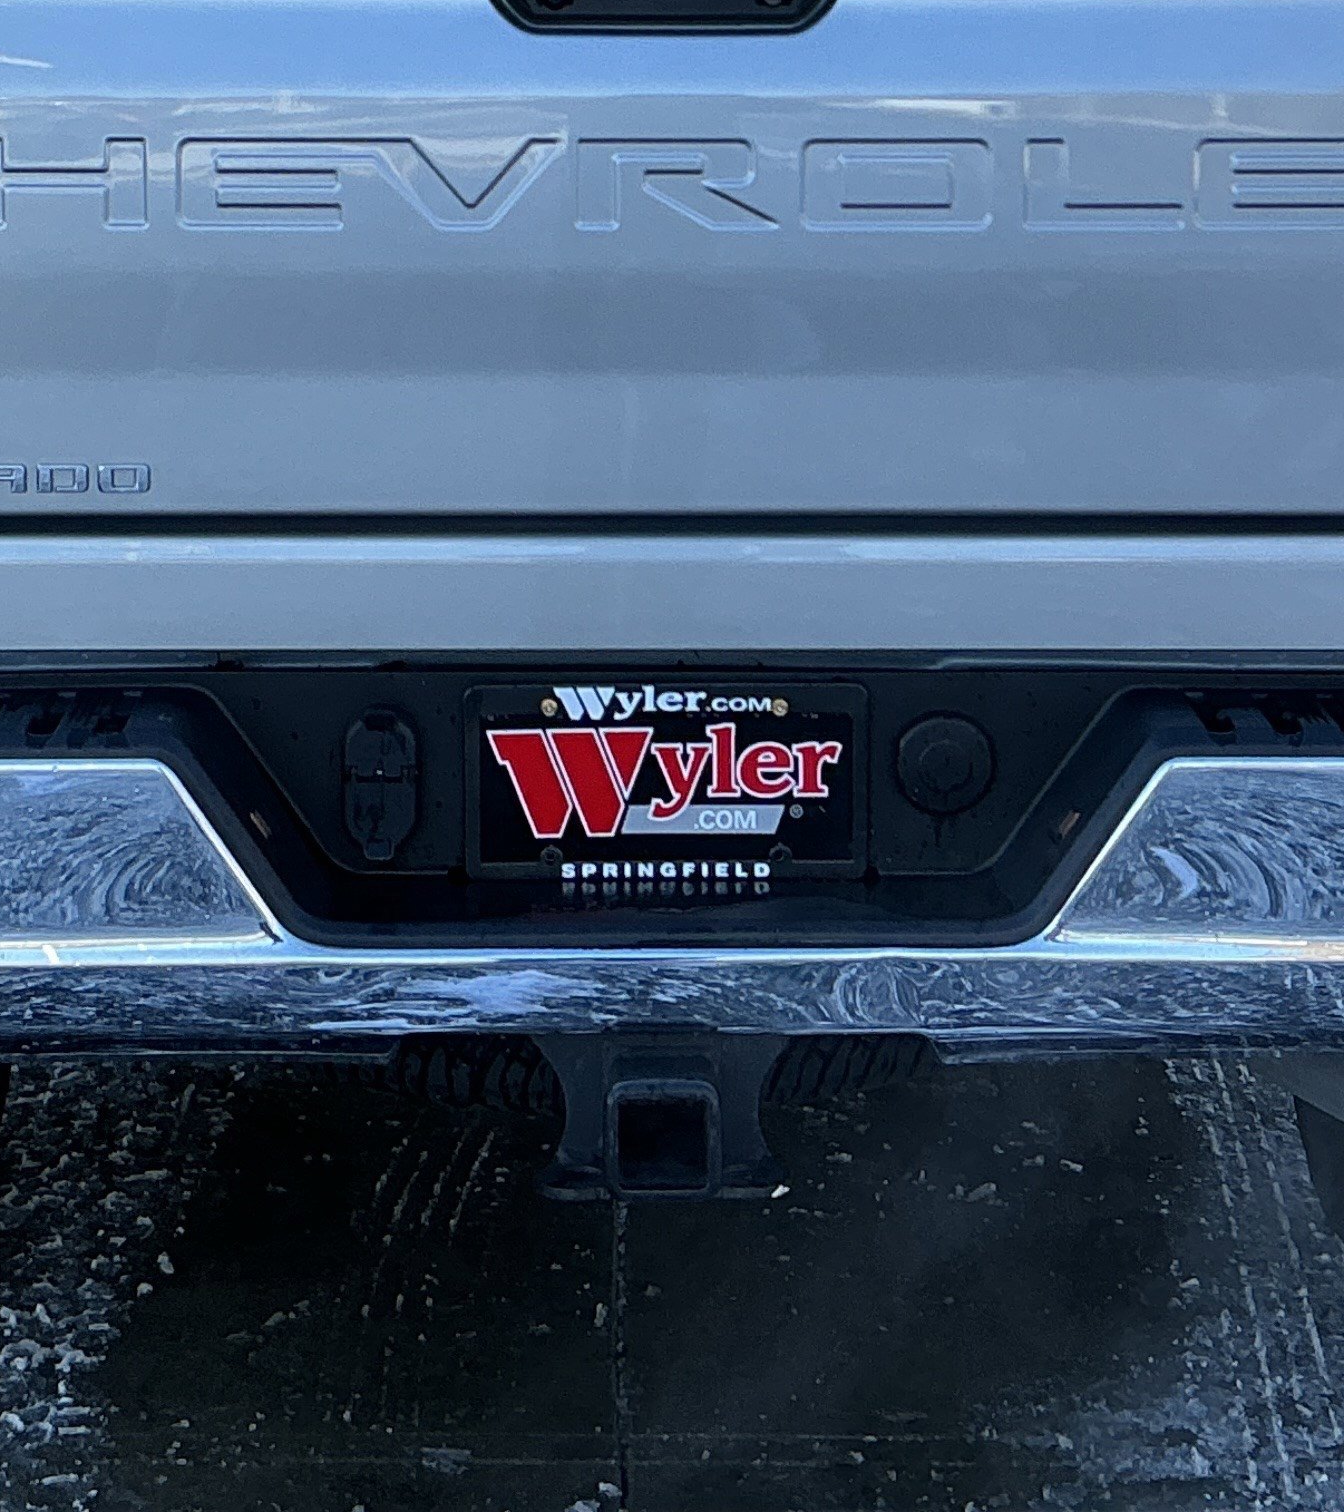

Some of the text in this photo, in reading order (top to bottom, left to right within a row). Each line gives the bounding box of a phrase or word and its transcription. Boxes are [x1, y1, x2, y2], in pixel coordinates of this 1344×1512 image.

[485, 722, 843, 840] Wyler
[693, 809, 758, 832] .COM
[560, 862, 771, 880] SPRINGFIELD
